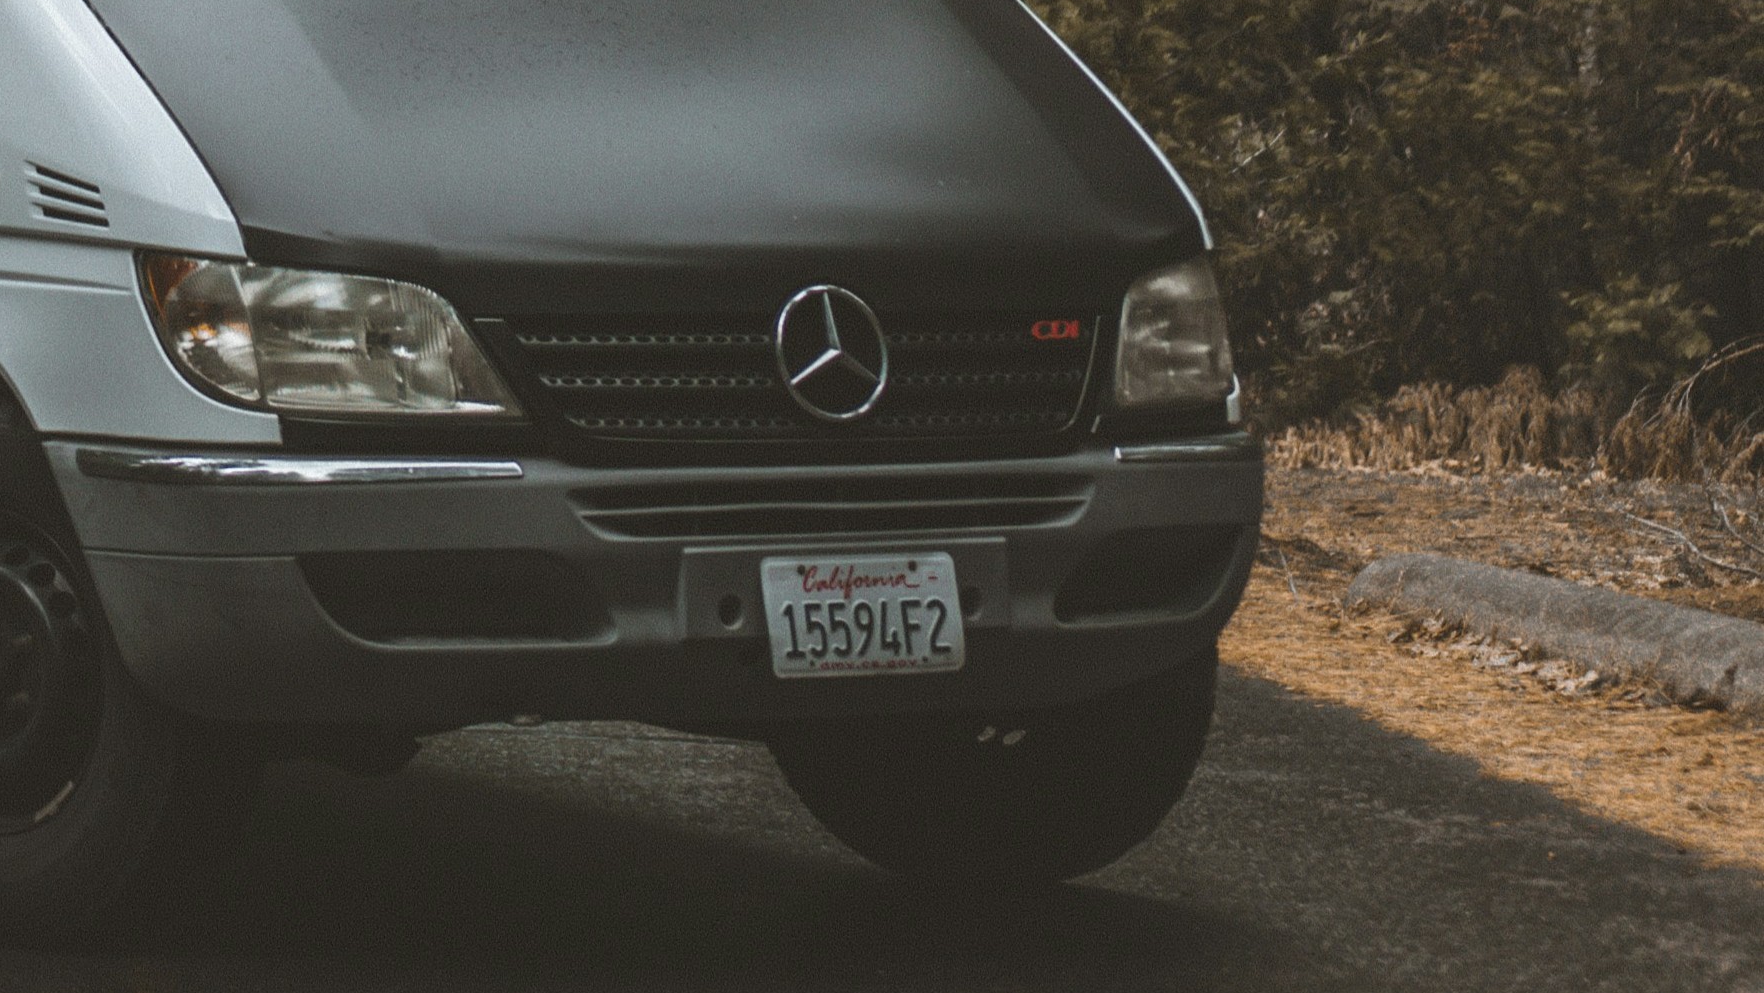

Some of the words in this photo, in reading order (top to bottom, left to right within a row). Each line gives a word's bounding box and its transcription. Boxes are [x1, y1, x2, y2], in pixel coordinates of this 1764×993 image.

[1031, 320, 1079, 340] CDI
[802, 564, 920, 599] California
[782, 599, 952, 658] 15594F2
